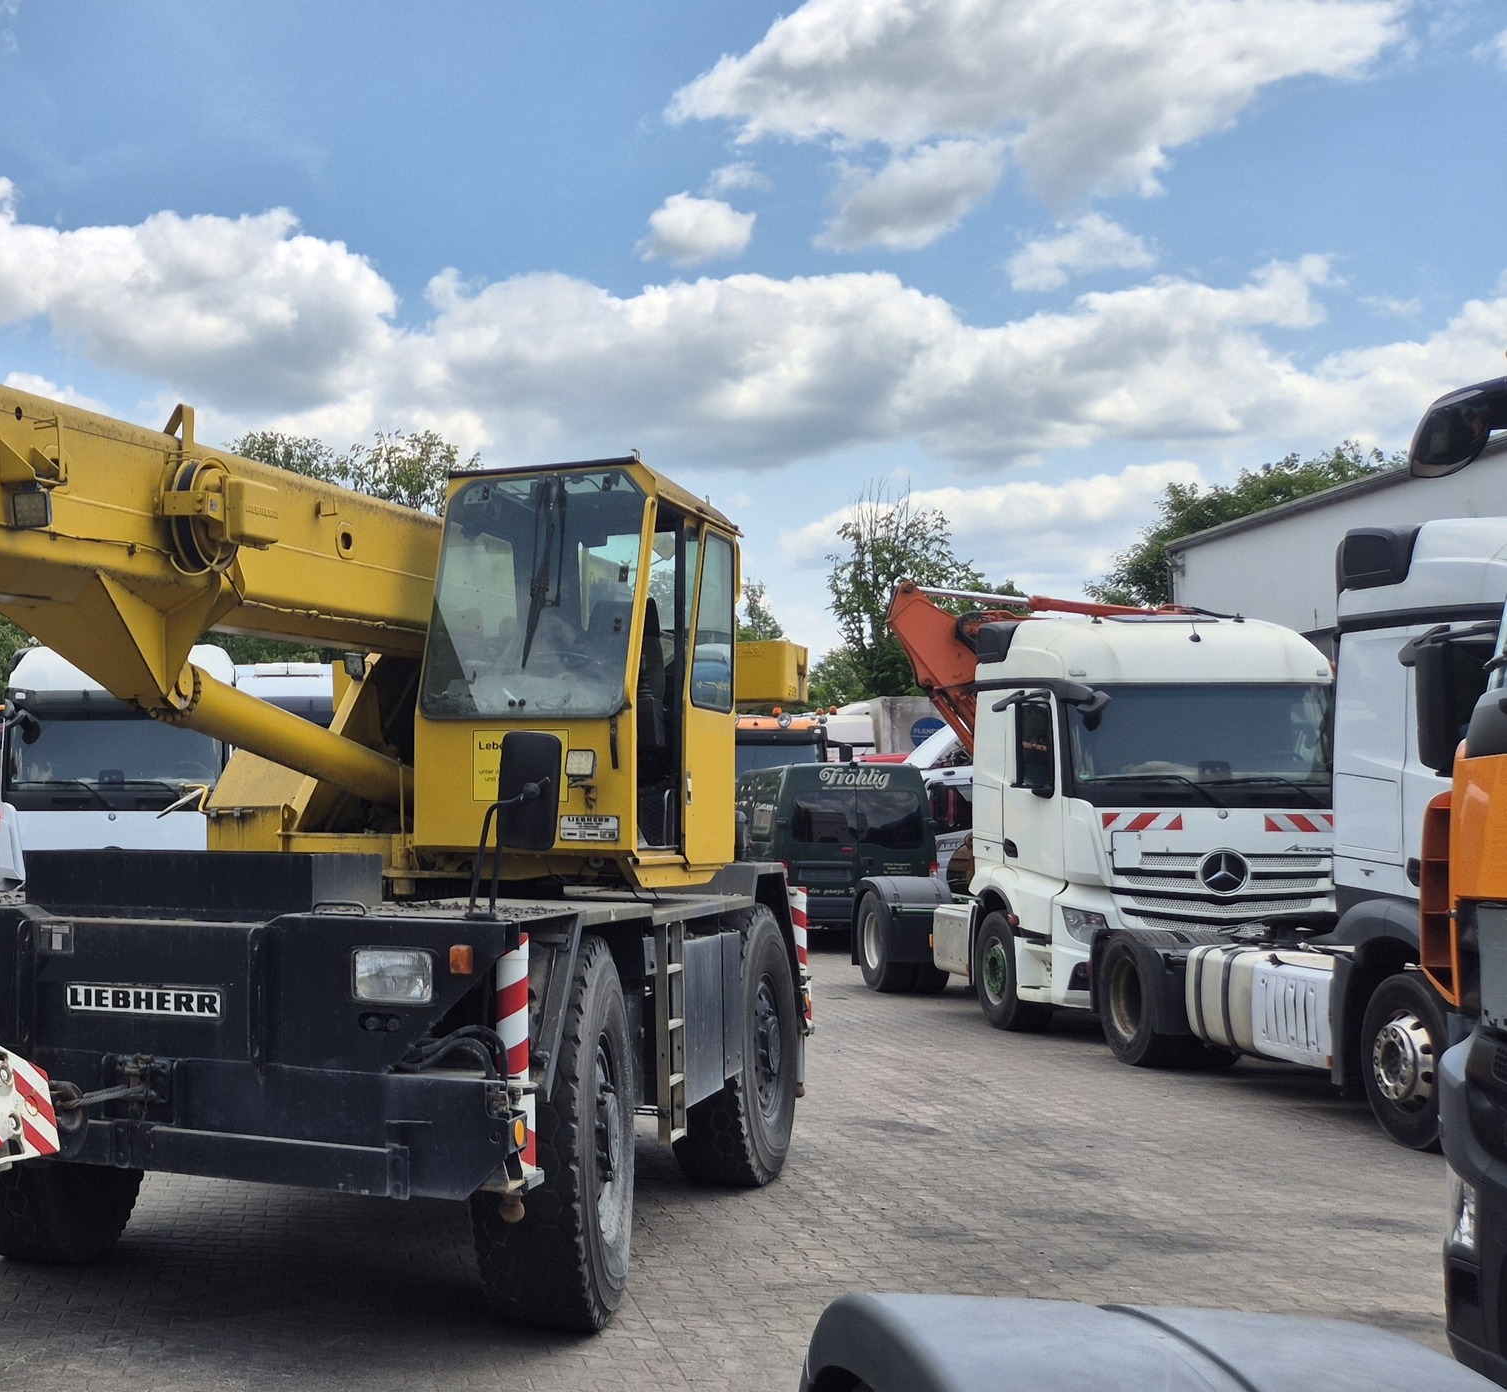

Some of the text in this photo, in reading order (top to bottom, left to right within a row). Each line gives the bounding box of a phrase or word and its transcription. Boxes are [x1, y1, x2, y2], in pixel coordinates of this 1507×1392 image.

[819, 766, 891, 790] Fröhlig
[938, 842, 964, 851] ABAS
[68, 987, 219, 1014] LIEBHERR
